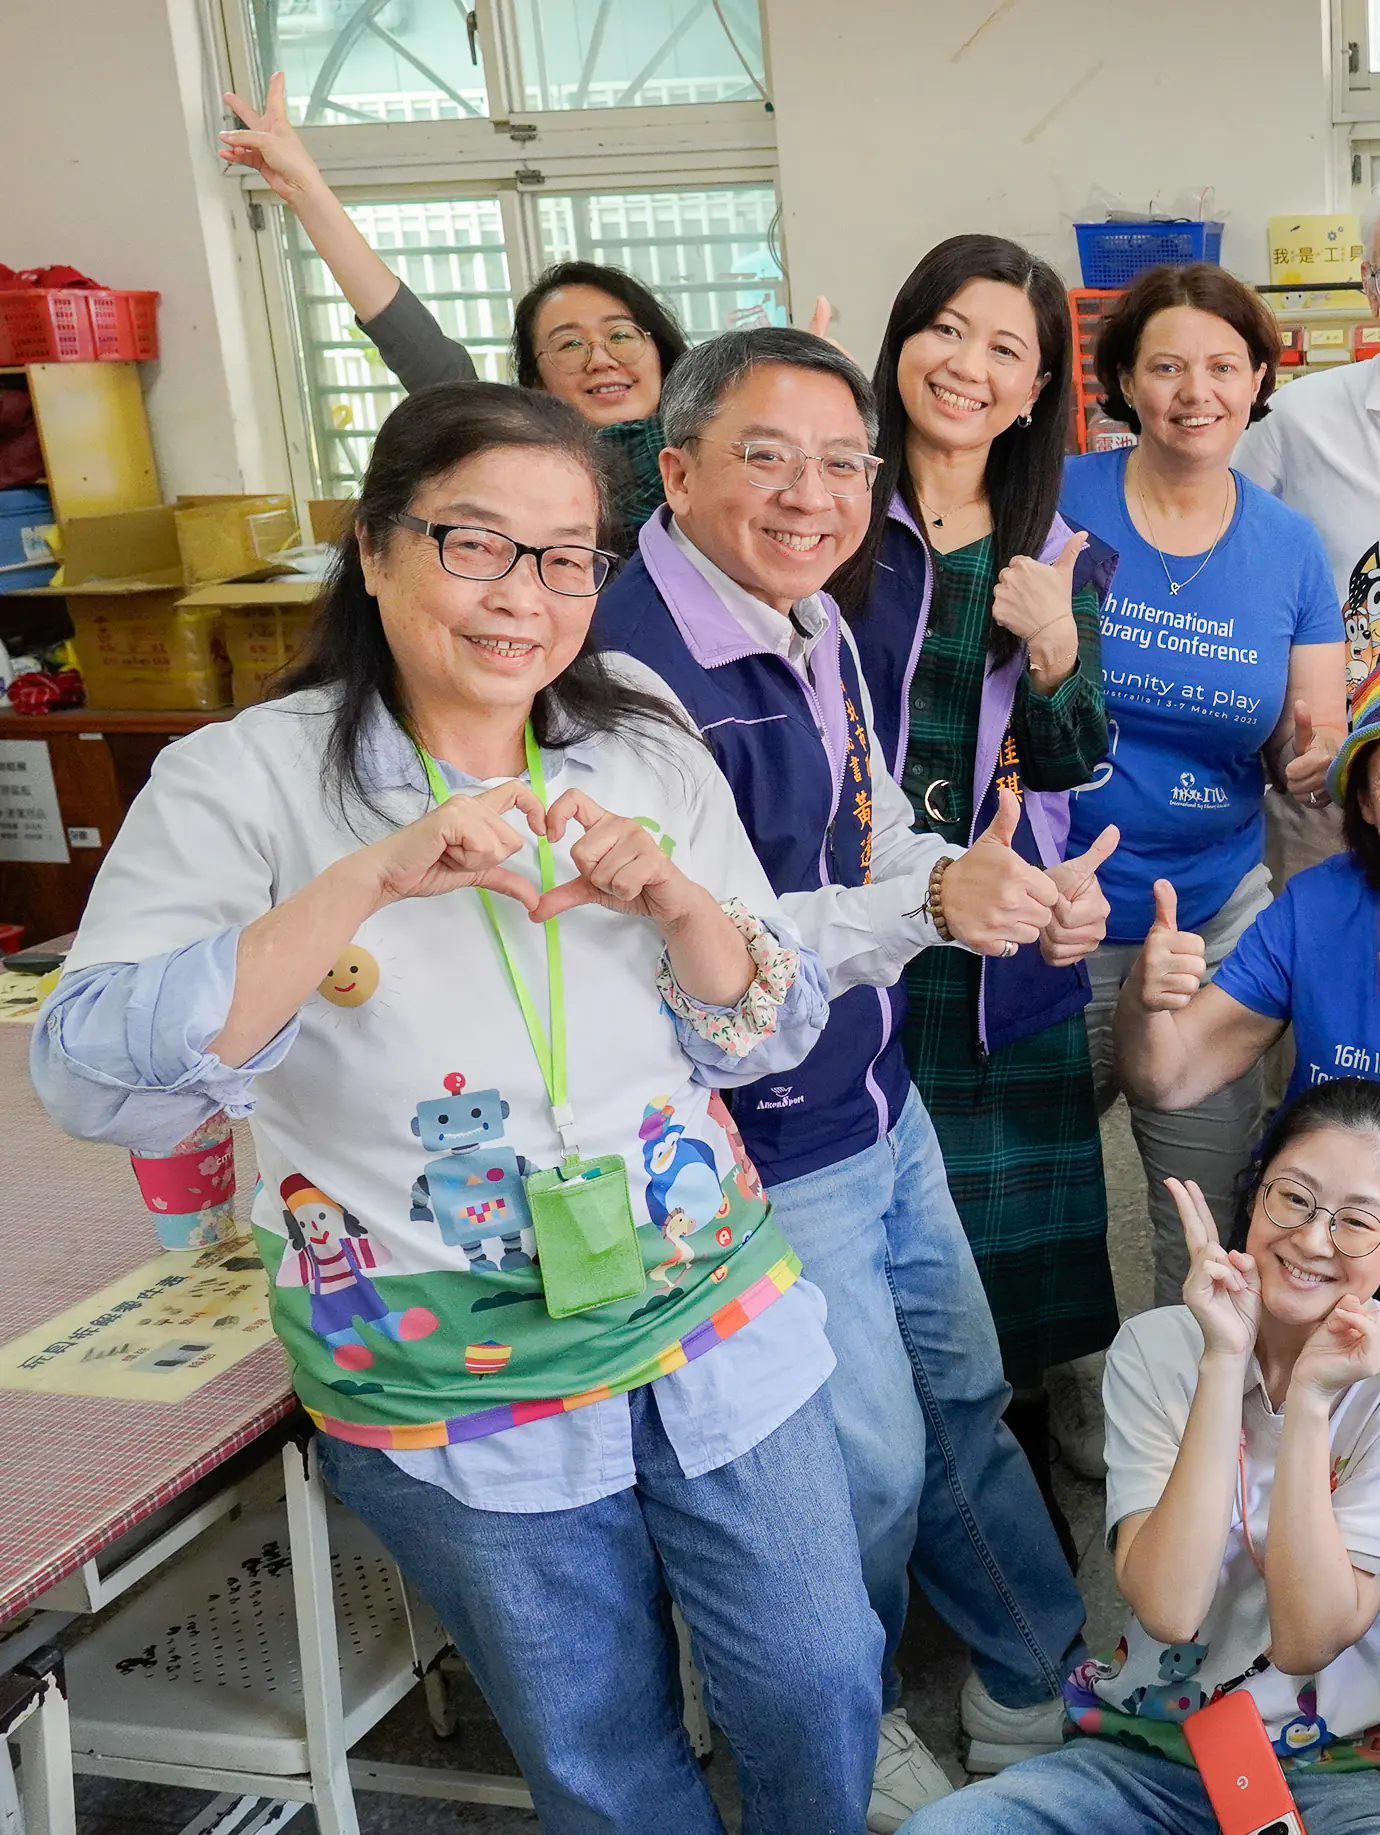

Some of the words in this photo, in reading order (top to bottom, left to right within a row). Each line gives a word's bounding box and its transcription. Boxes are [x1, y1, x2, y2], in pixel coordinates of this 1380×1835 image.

[1121, 597, 1234, 638] International
[1100, 615, 1152, 649] ibrary
[1157, 630, 1258, 665] Conference
[1103, 689, 1151, 703] ustralia
[1191, 705, 1228, 719] March
[1181, 685, 1205, 700] at
[1213, 689, 1261, 714] play
[1334, 1044, 1371, 1072] 16th
